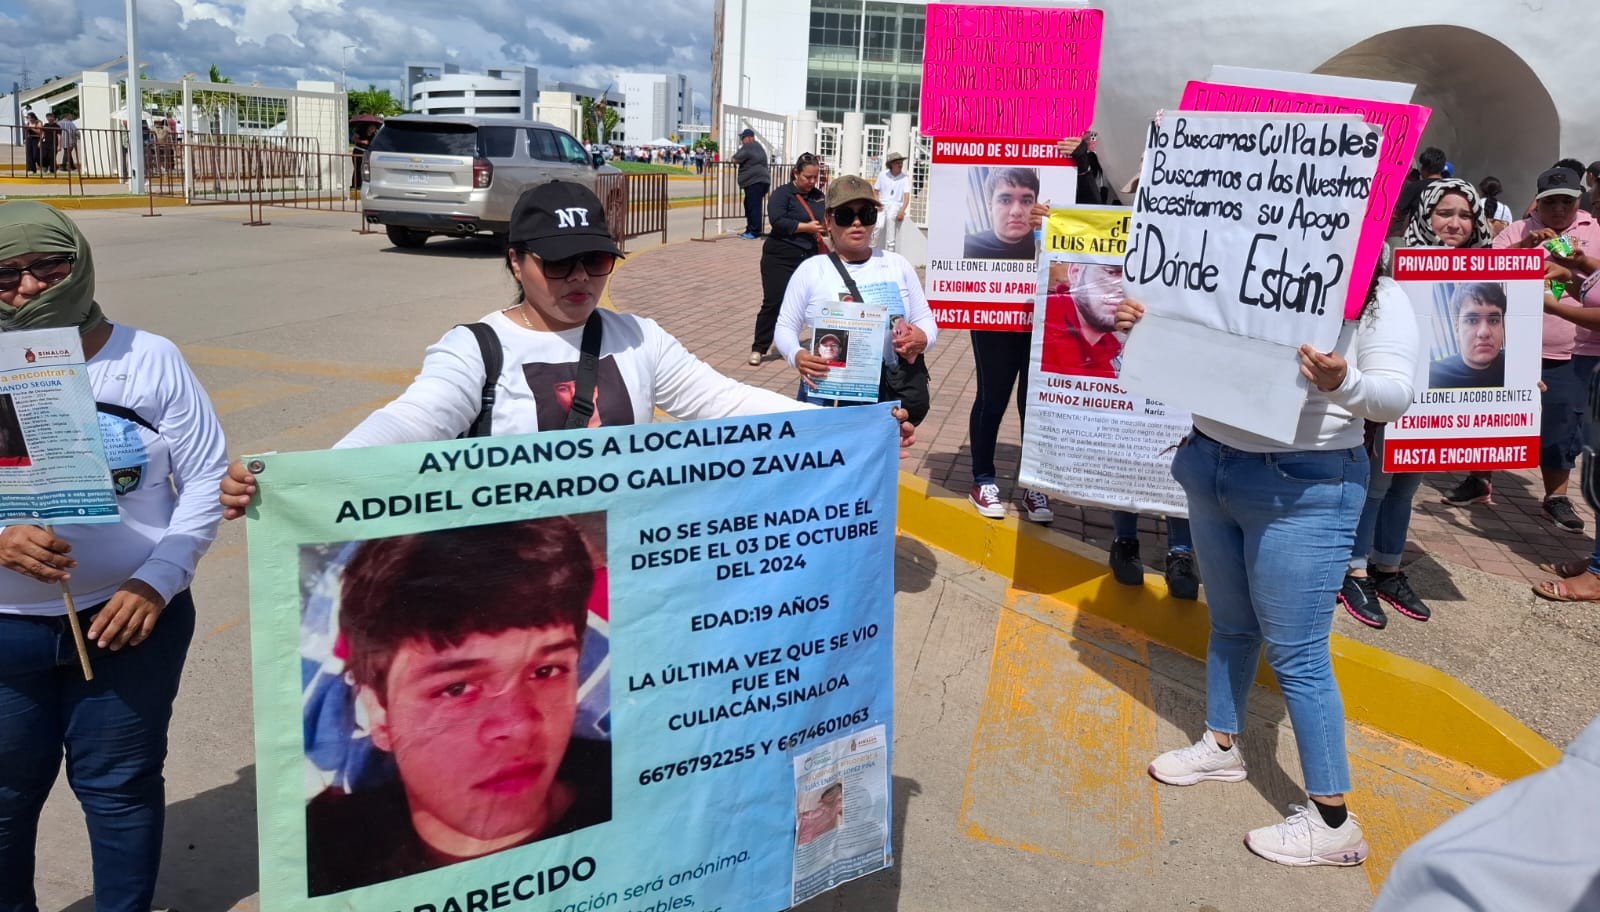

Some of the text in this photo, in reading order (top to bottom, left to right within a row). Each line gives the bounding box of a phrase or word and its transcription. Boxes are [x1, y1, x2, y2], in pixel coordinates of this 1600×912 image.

[1030, 10, 1098, 40] BUSCAMOS
[1148, 121, 1168, 149] No
[1173, 118, 1256, 153] Buscamos
[936, 143, 1073, 159] PRIVADO DE SU LIBERT
[1151, 151, 1241, 188] Buscamos
[1247, 173, 1262, 191] a
[1296, 163, 1371, 199] Nuestros
[554, 207, 590, 228] NY
[1137, 187, 1350, 241] Necesitamos su Apoyo
[1052, 235, 1085, 251] LUIS
[932, 260, 1037, 273] PAUL LEONEL JACOBO BE
[1124, 222, 1343, 315] ¿Dónde Están?
[1399, 255, 1540, 271] PRIVADO DE SU LIBERTAD
[939, 281, 987, 293] EXIGIMOS
[989, 282, 1002, 293] SU
[933, 310, 971, 324] HASTA
[11, 369, 65, 381] encontrar
[30, 380, 62, 388] SEGURA
[1047, 377, 1071, 389] LUIS
[1039, 391, 1134, 411] MUÑOZ HIGUERA
[1421, 392, 1456, 403] LEONEL
[1458, 391, 1493, 403] JACOBO
[1496, 390, 1532, 402] BENITEZ
[1144, 408, 1166, 416] Nariz:
[1402, 415, 1453, 429] EXIGIMOS
[1457, 415, 1470, 428] SU
[1473, 413, 1527, 427] APARICION
[1531, 413, 1534, 426] !
[419, 421, 795, 474] AYÚDANOS A LOCALIZAR A
[1394, 446, 1527, 464] HASTA ENCONTRARTE
[336, 449, 845, 523] ADDIEL GERARDO GALINDO ZAVALA
[640, 500, 872, 544] NO SE SABE NADA DE ÉL
[632, 520, 878, 570] DESDE EL 03 DE OCTUBRE
[717, 554, 806, 580] DEL 2024
[692, 595, 829, 631] EDAD:19 AÑOS
[629, 624, 878, 691] LA ÚLTIMA VEZ QUE SE VIO
[732, 667, 799, 694] FUE EN
[668, 673, 849, 732] CULIACÁN,SINALOA
[639, 707, 869, 785] 6676792255 Y 6674601063
[398, 856, 596, 912] ARECIDO
[556, 849, 751, 912] ación será anónima.
[628, 894, 695, 912] ables,
